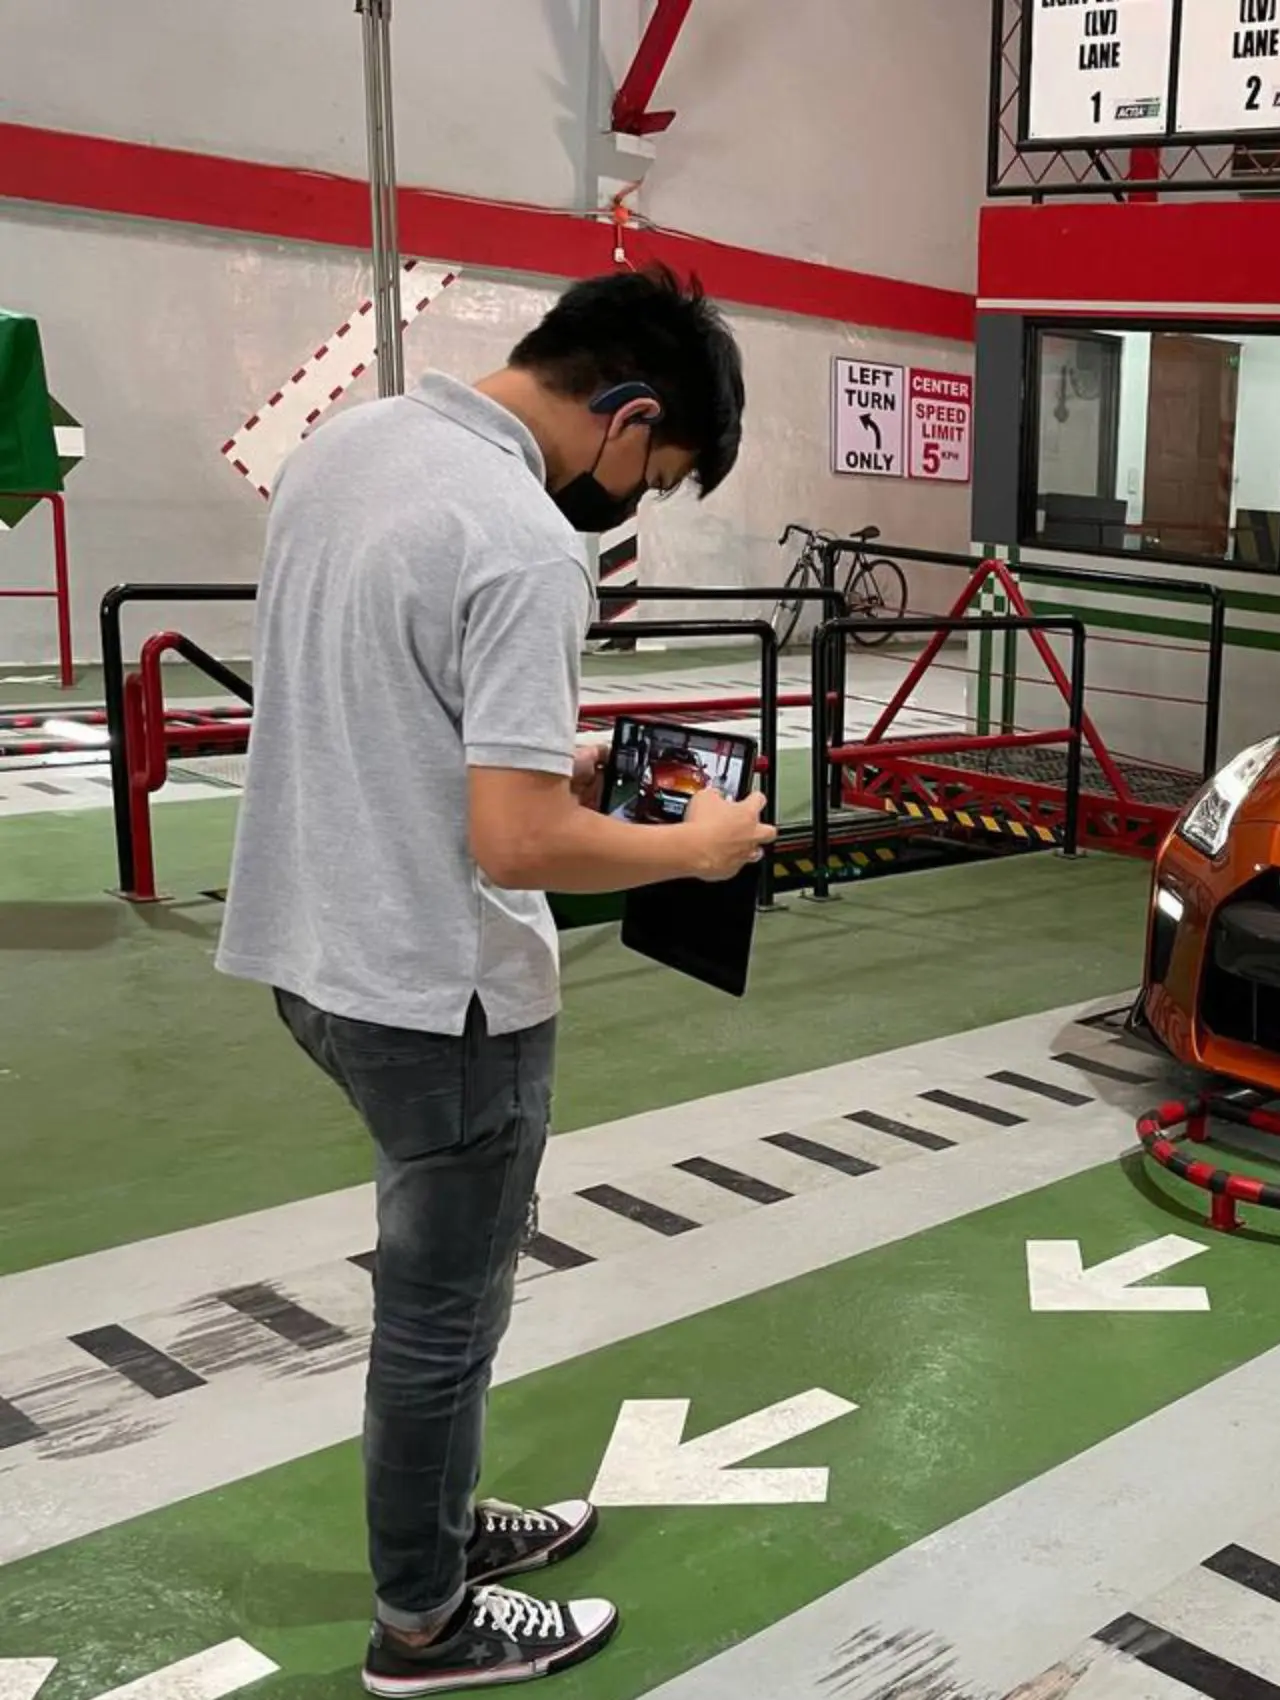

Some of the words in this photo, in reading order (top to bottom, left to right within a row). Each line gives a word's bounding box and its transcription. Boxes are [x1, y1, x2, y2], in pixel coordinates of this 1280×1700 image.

[1085, 9, 1117, 36] (LV)
[1240, 0, 1276, 23] (LV)
[1232, 28, 1280, 59] LANE
[1079, 42, 1121, 70] LANE
[1245, 75, 1262, 110] 2
[1091, 91, 1101, 123] 1
[848, 365, 894, 388] LEFT
[912, 375, 969, 398] CENTER
[844, 388, 896, 411] TURN
[916, 403, 967, 424] SPEED
[922, 423, 964, 442] LIMIT
[845, 451, 895, 472] ONLY
[923, 442, 940, 474] 5
